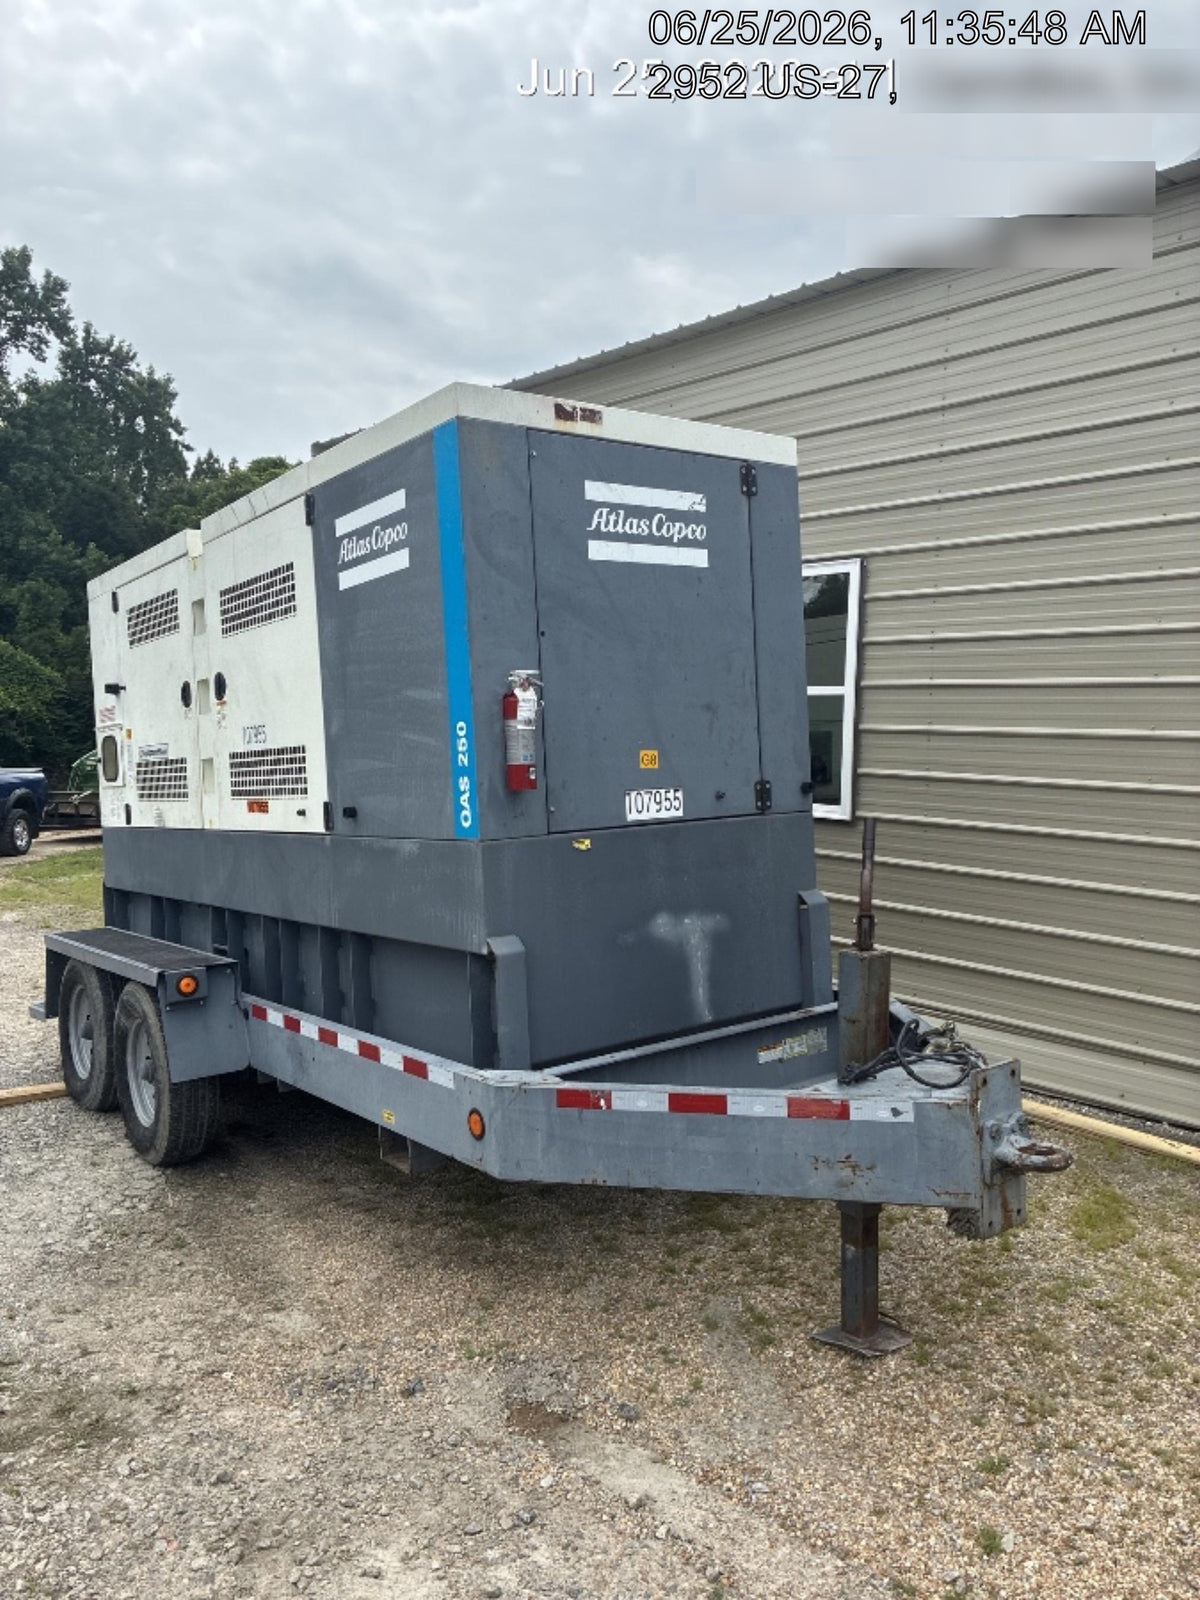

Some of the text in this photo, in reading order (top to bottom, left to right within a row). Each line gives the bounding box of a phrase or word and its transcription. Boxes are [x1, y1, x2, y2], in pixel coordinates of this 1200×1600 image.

[586, 507, 707, 543] Atlas Copco
[337, 522, 408, 565] Atlas Copco
[456, 721, 469, 767] 250
[641, 753, 657, 767] G8
[626, 788, 682, 815] 107955
